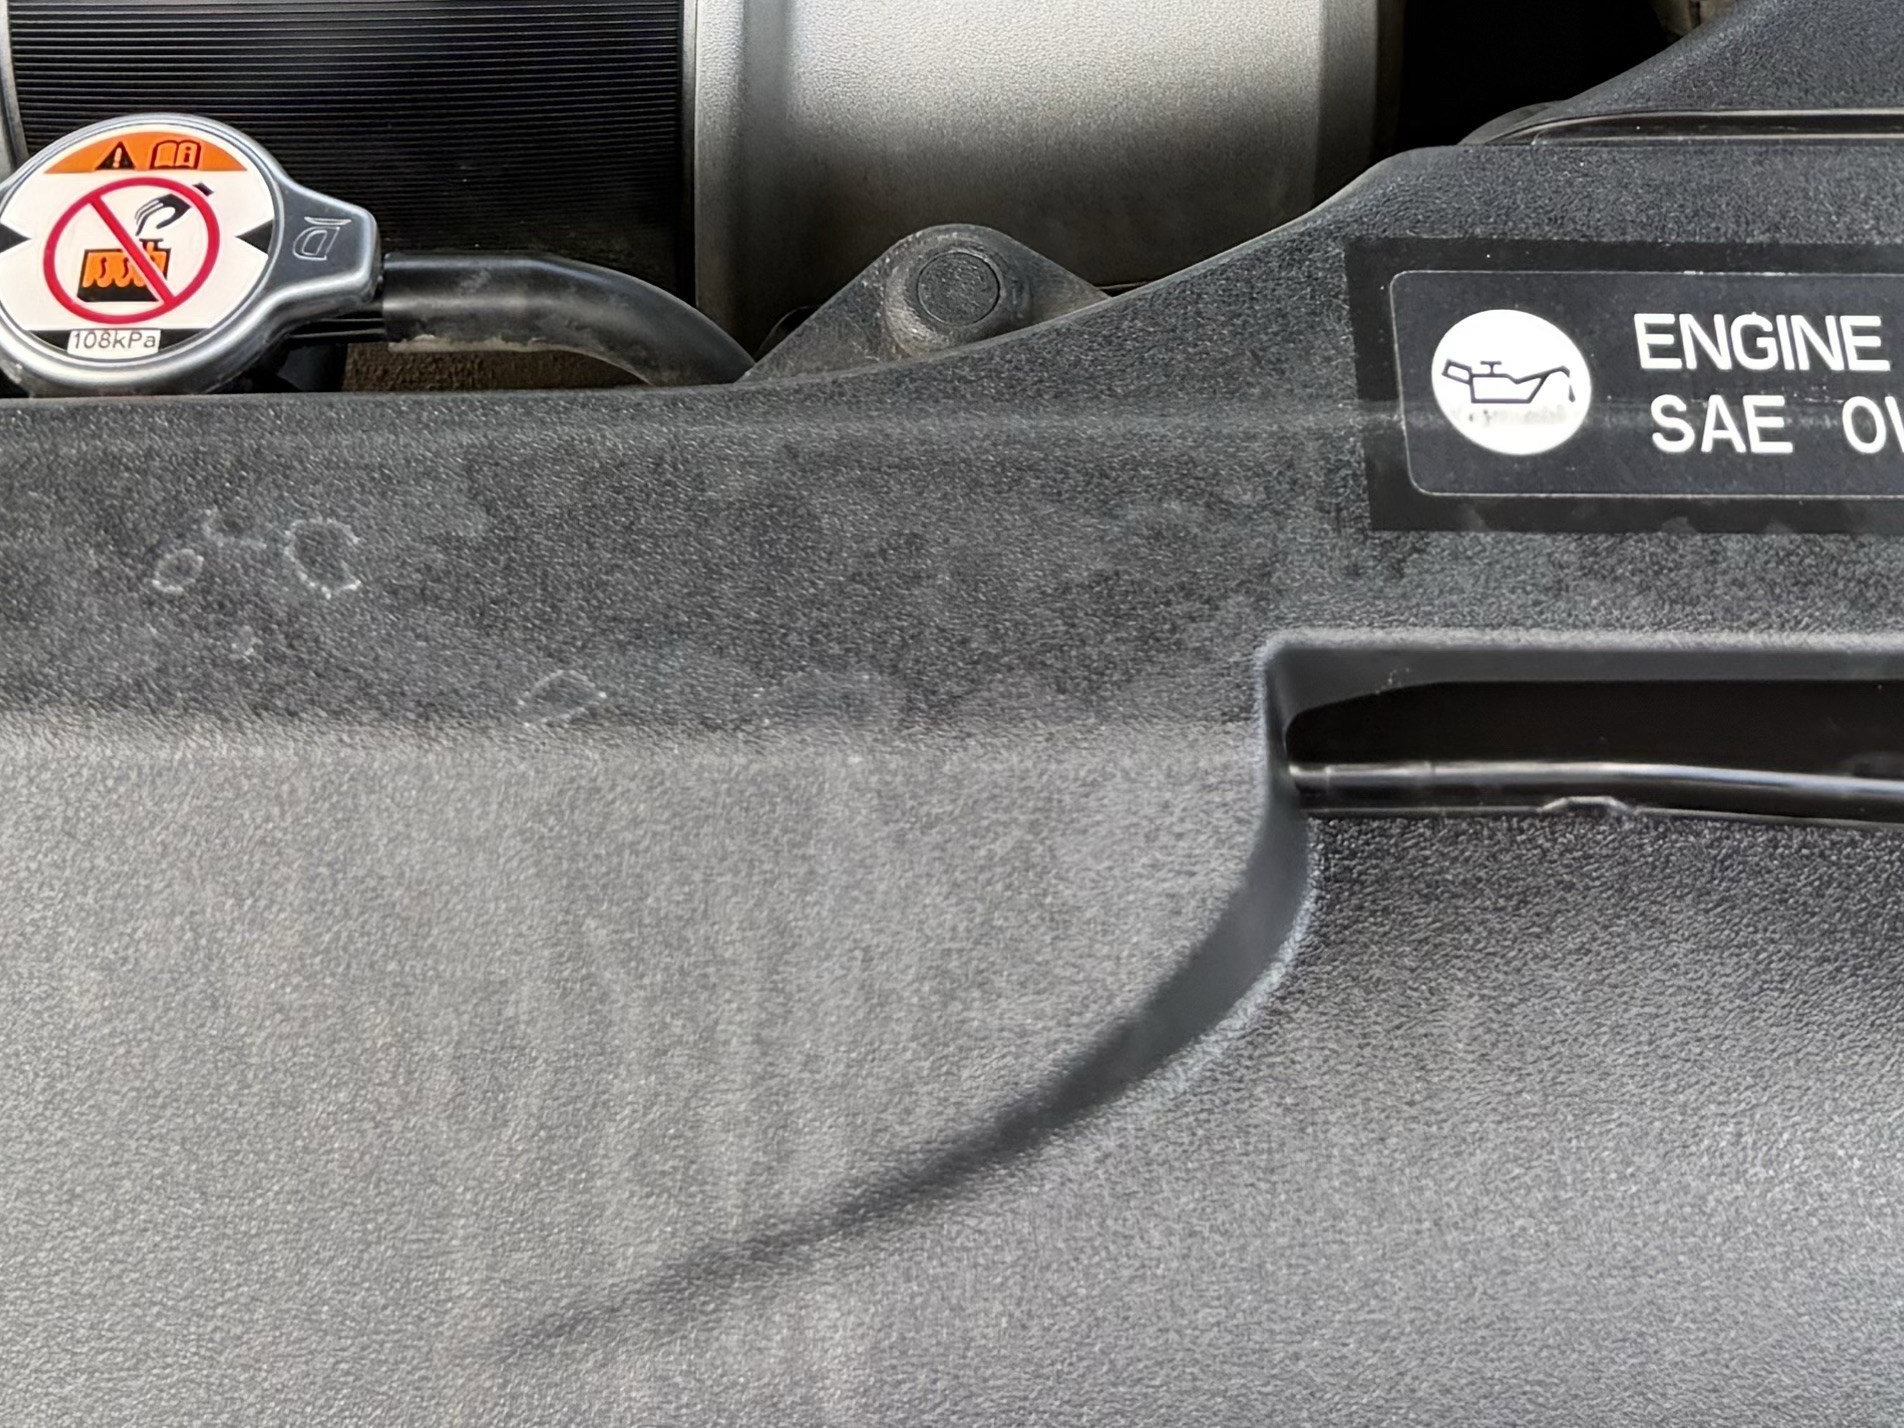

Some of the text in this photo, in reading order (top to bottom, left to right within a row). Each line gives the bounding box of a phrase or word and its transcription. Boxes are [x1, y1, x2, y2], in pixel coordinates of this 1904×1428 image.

[73, 331, 158, 350] 108kPa
[1633, 311, 1891, 372] ENGINE
[1650, 393, 1794, 454] SAE
